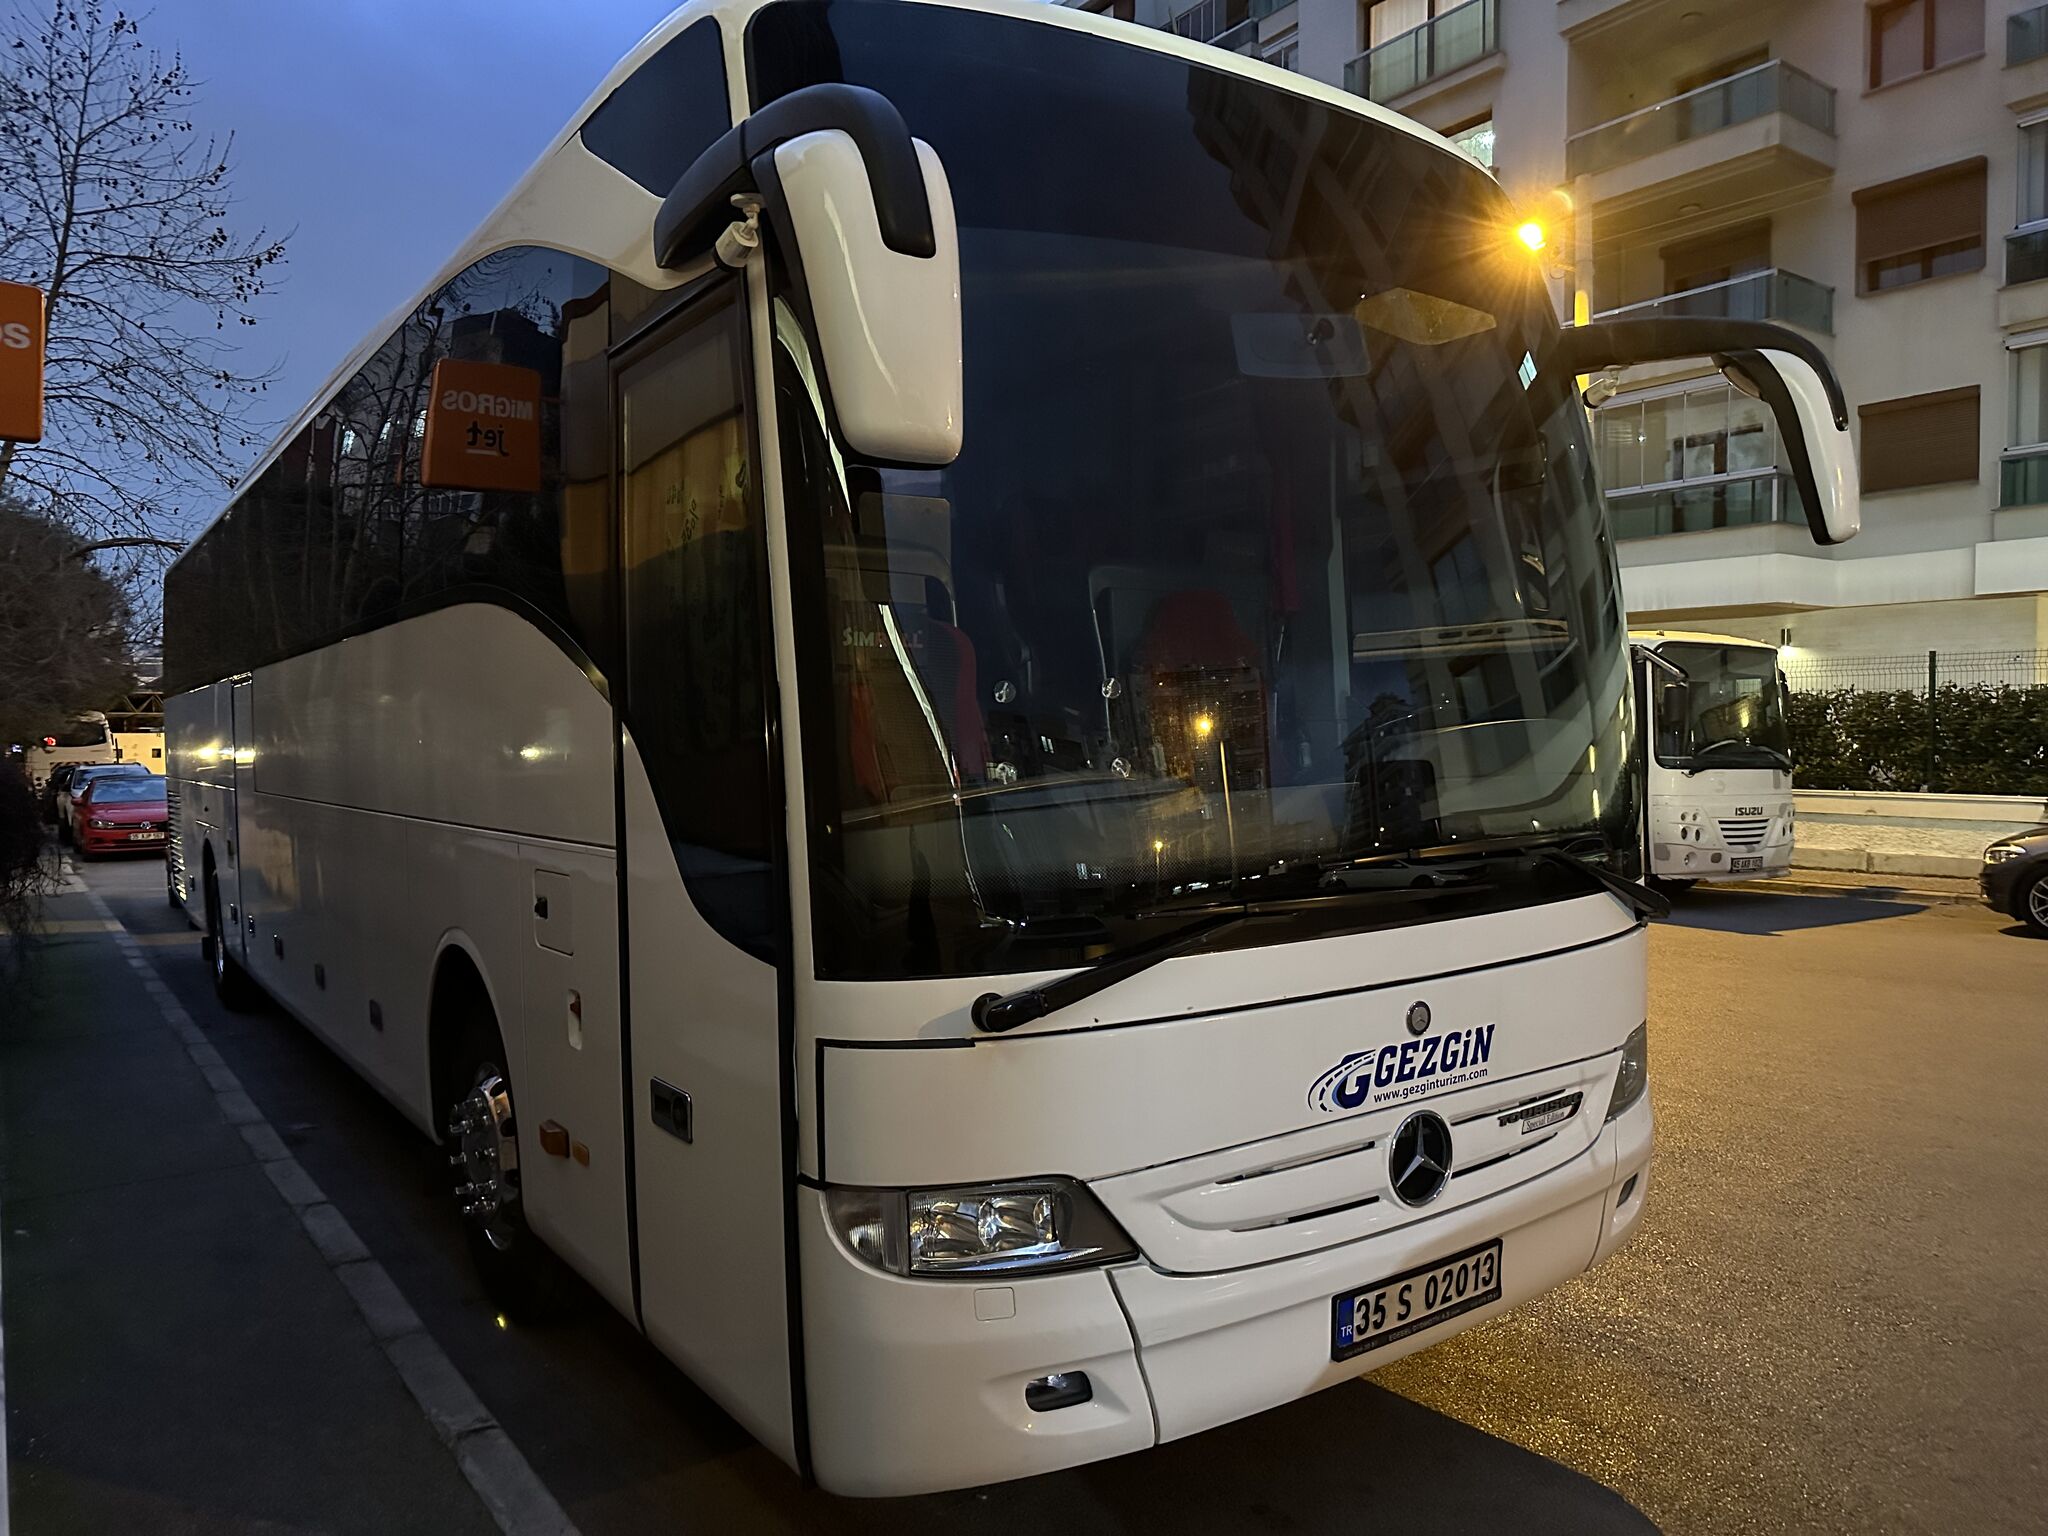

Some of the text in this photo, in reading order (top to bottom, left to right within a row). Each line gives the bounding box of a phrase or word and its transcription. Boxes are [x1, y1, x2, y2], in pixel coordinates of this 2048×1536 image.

[0, 322, 31, 350] S
[1734, 806, 1764, 817] ISUZU
[1374, 1067, 1488, 1103] www.gezginturizm.com
[1526, 1110, 1565, 1131] Special Edition
[1355, 1292, 1387, 1336] 35
[1397, 1284, 1412, 1321] S
[1424, 1252, 1495, 1310] 02013
[1341, 1325, 1353, 1338] TR
